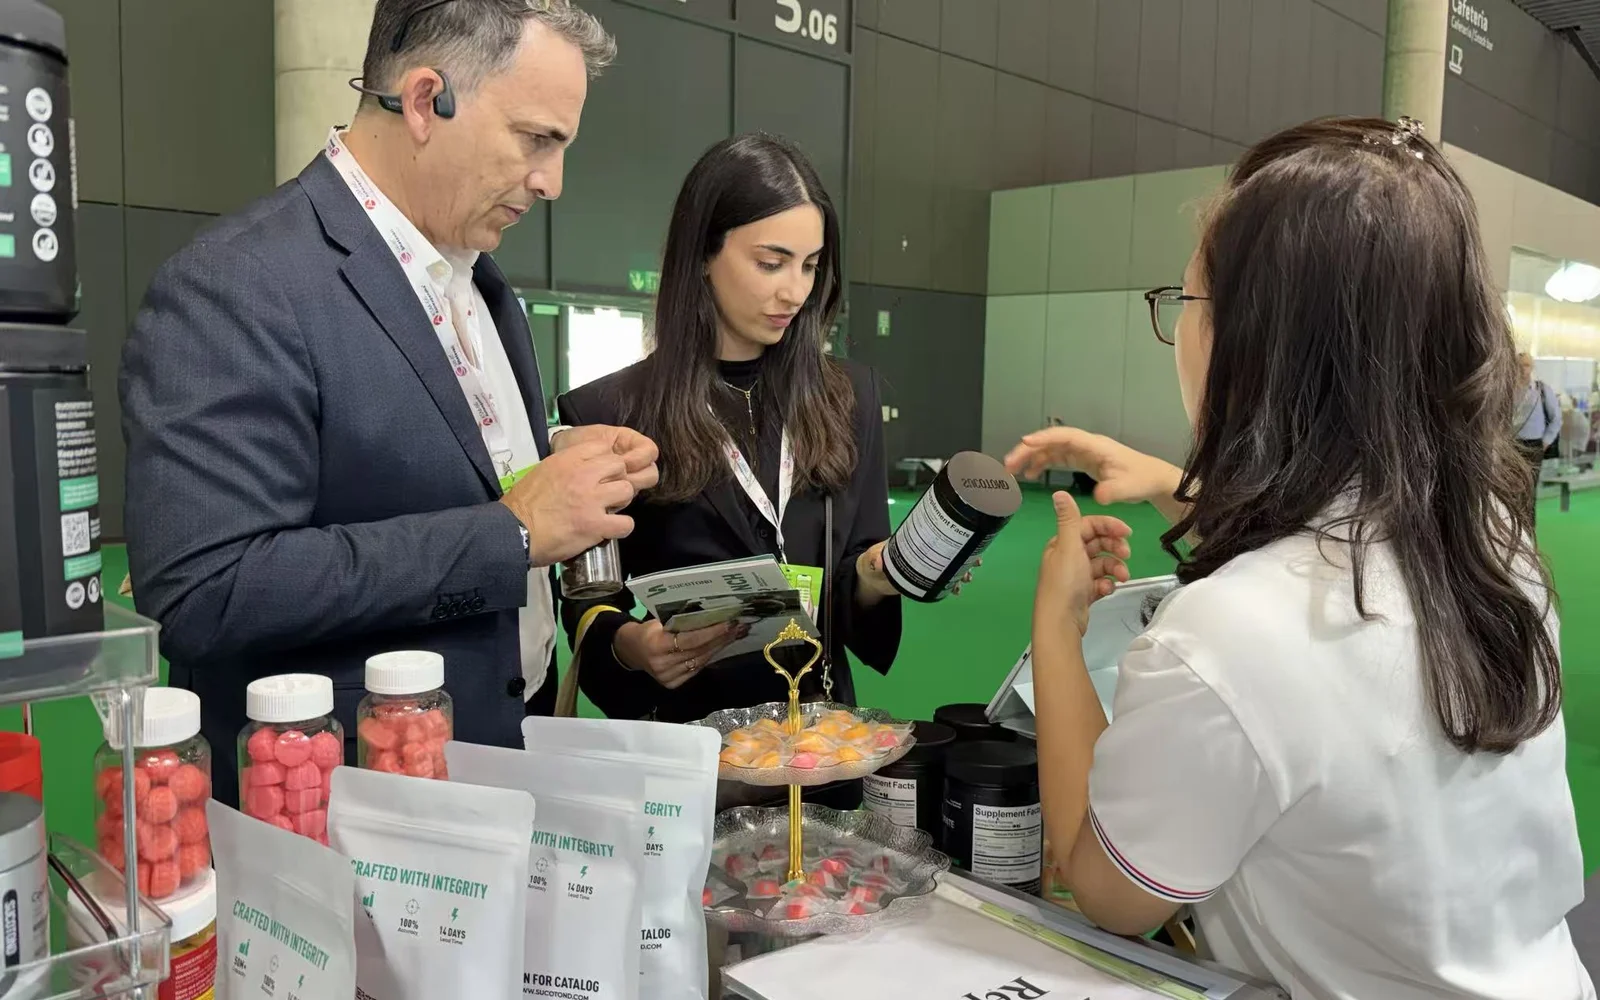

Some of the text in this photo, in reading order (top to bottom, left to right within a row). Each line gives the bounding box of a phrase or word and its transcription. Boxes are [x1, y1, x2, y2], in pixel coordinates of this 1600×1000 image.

[949, 523, 970, 538] Facts
[892, 781, 915, 789] Facts
[644, 801, 682, 817] EGRITY
[975, 807, 1025, 818] Supplement
[558, 836, 614, 857] INTEGRITY
[646, 843, 663, 851] DAYS
[400, 868, 430, 888] WITH
[431, 874, 488, 899] INTEGRITY
[530, 875, 547, 886] 100%
[568, 883, 593, 895] 14 DAYS
[400, 918, 419, 930] 100%
[233, 900, 330, 971] CRAFTED WITH INTEGRITY
[439, 926, 466, 939] 14 DAYS
[641, 928, 671, 940] TALOG
[532, 974, 552, 986] FOR
[554, 976, 599, 992] CATALOG
